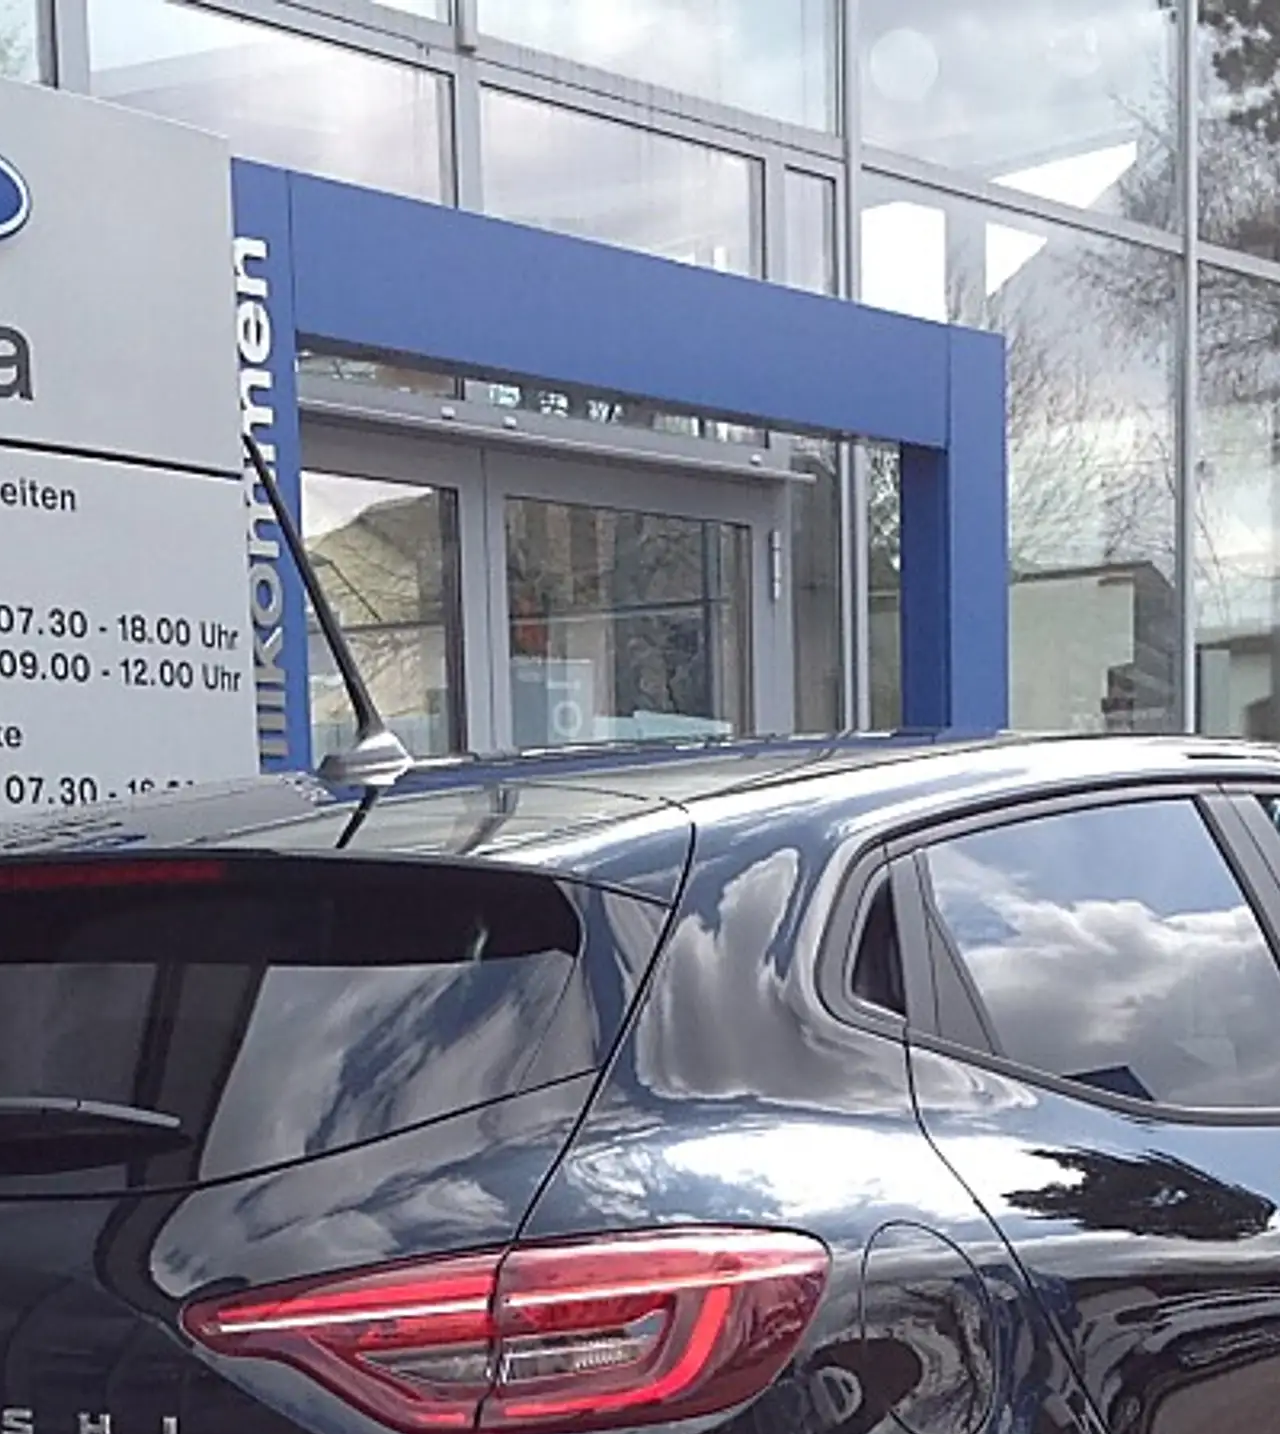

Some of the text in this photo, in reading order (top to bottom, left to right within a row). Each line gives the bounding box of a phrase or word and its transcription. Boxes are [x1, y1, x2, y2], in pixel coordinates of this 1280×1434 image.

[118, 614, 192, 647] 18.00
[200, 621, 239, 650] Uhr
[120, 658, 194, 689] 12.00
[202, 663, 241, 692] Uhr
[4, 774, 98, 805] 07.30
